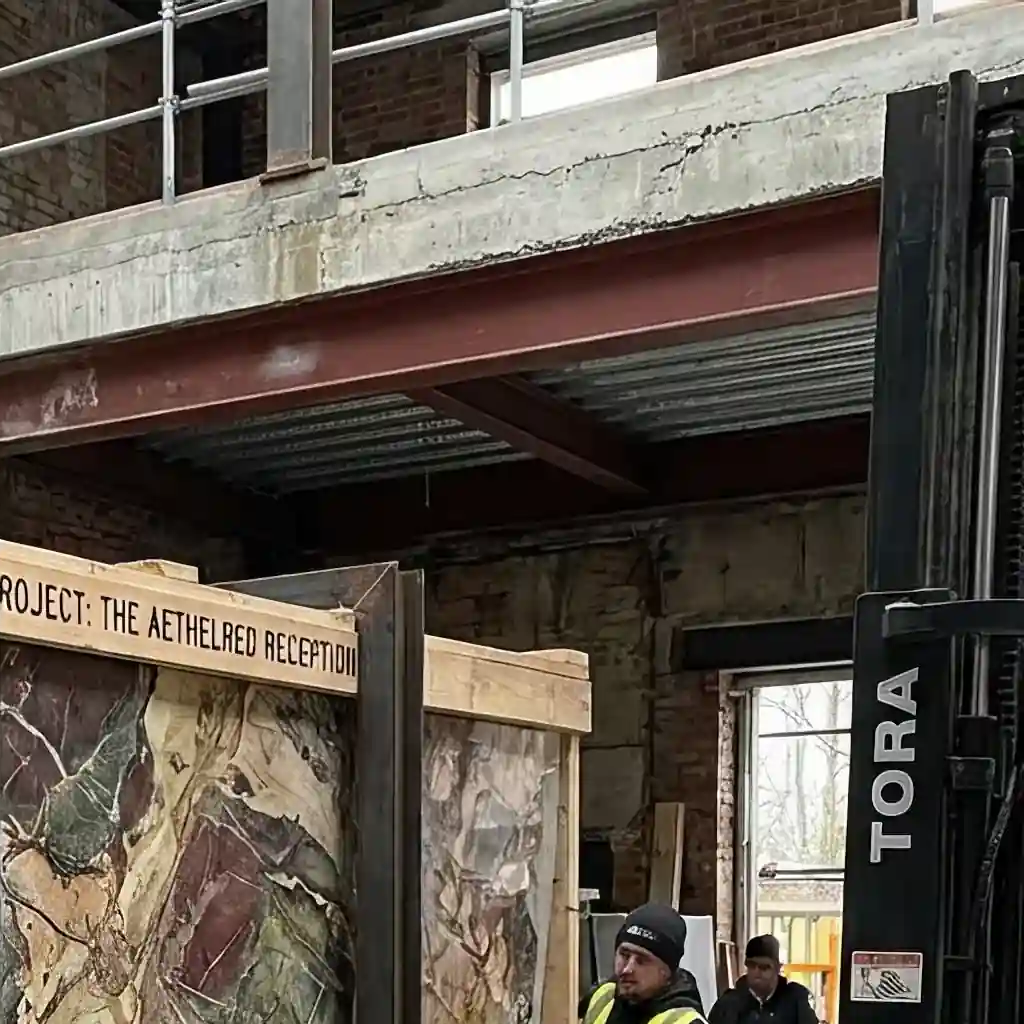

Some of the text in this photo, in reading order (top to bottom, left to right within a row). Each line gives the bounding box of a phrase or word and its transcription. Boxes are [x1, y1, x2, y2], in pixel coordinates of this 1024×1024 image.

[0, 574, 91, 627] ROJECT:
[100, 595, 140, 636] THE
[147, 605, 257, 658] AETHELRED
[869, 666, 920, 864] TORA
